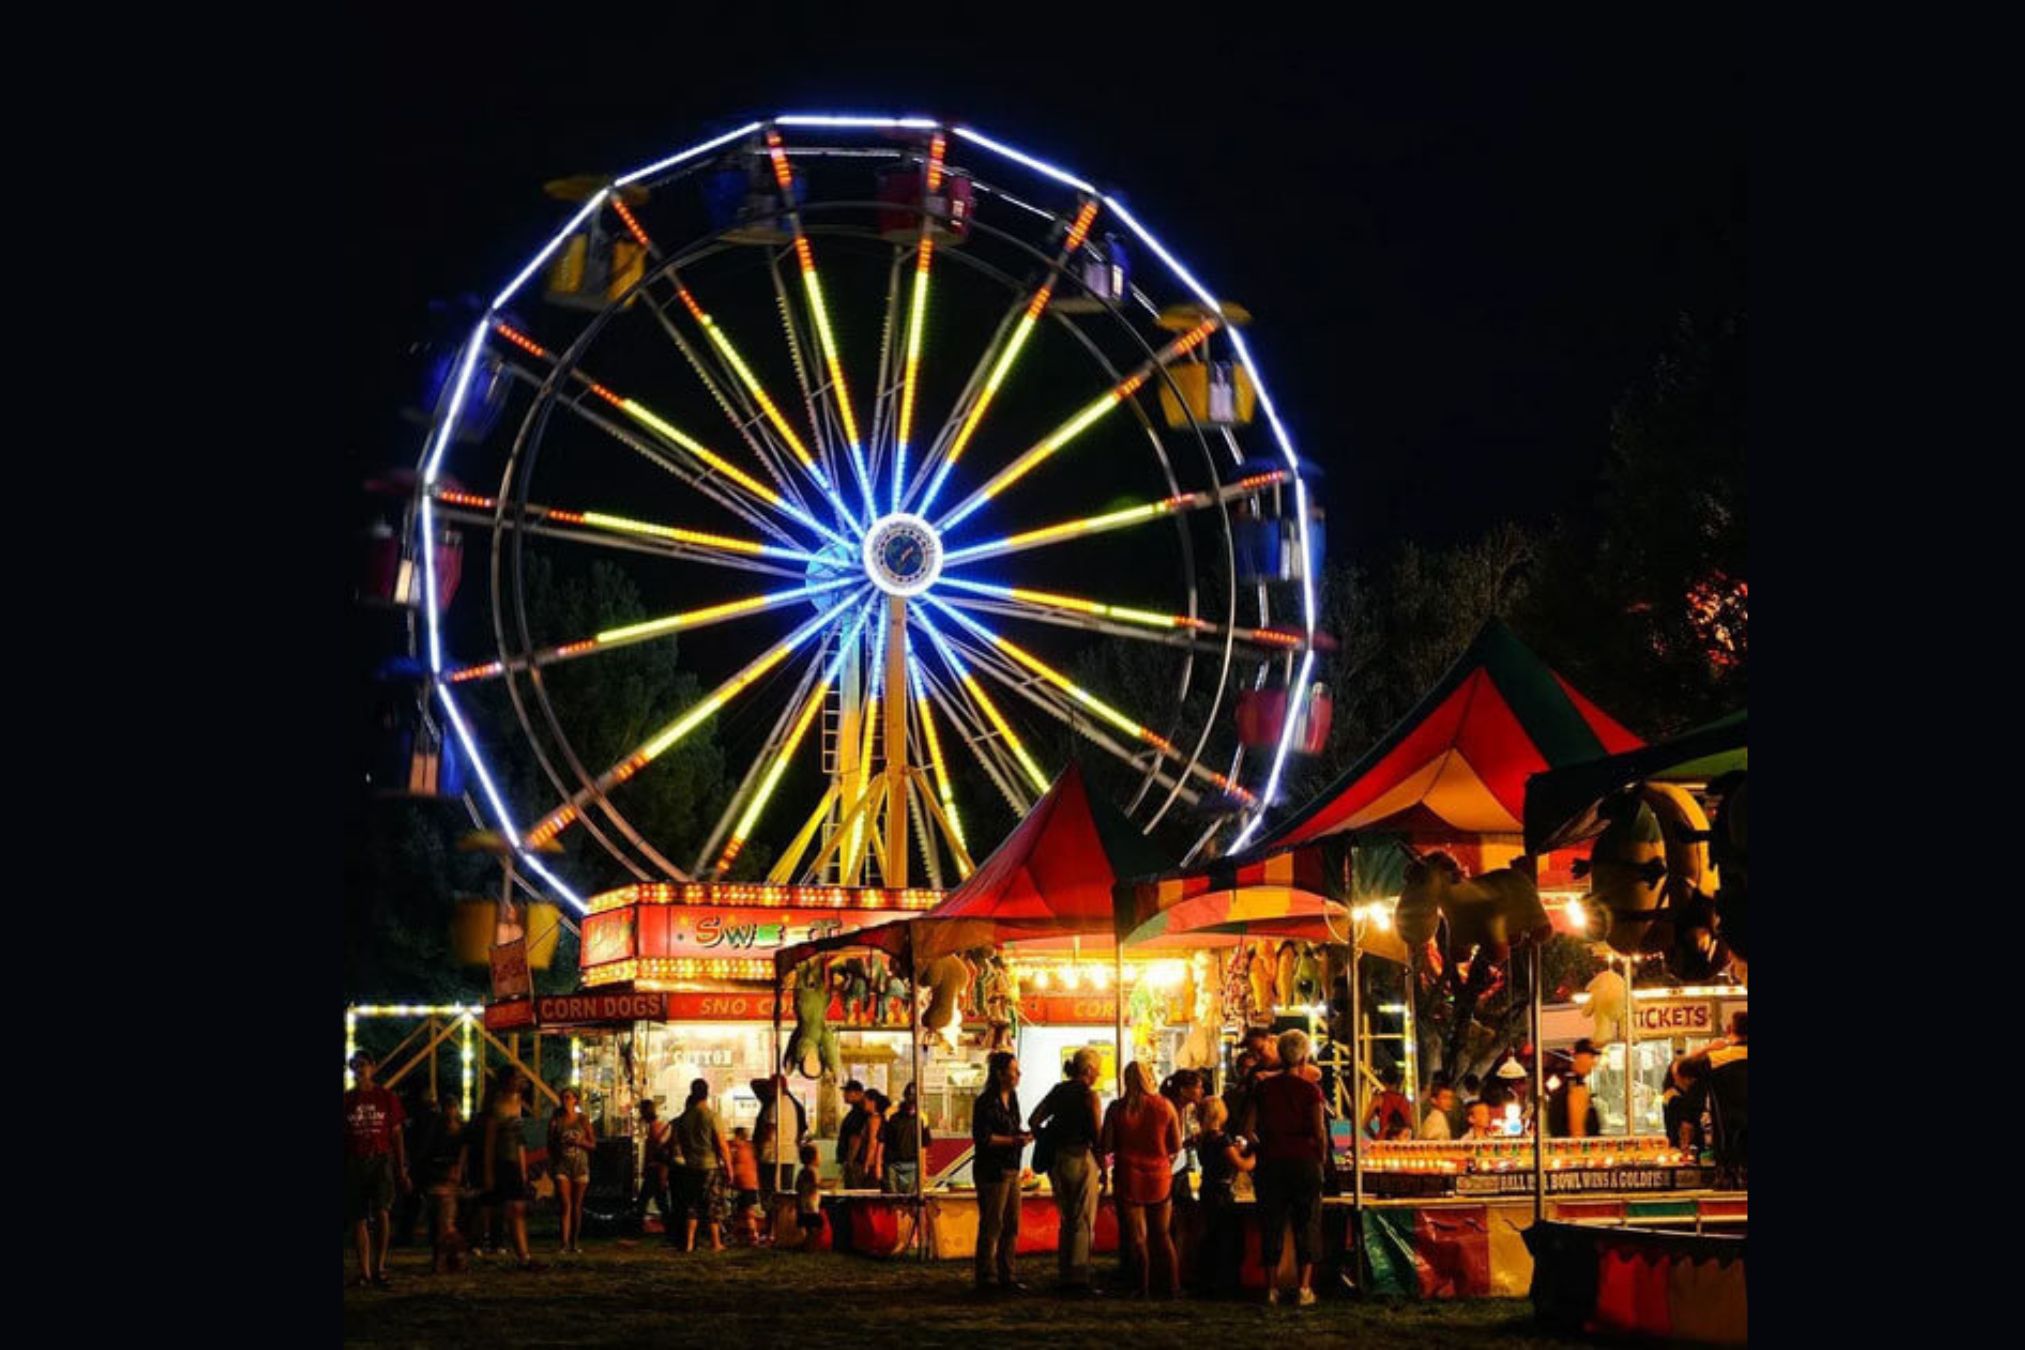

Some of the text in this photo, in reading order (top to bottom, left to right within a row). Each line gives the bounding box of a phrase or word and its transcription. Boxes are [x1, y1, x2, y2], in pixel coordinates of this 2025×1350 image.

[541, 998, 597, 1019] CORN
[603, 994, 660, 1017] DOGS
[701, 999, 747, 1016] SNO
[1074, 1001, 1116, 1018] COR
[1630, 1003, 1708, 1030] TICKETS
[1551, 1172, 1582, 1190] BOWL
[1610, 1170, 1619, 1188] A
